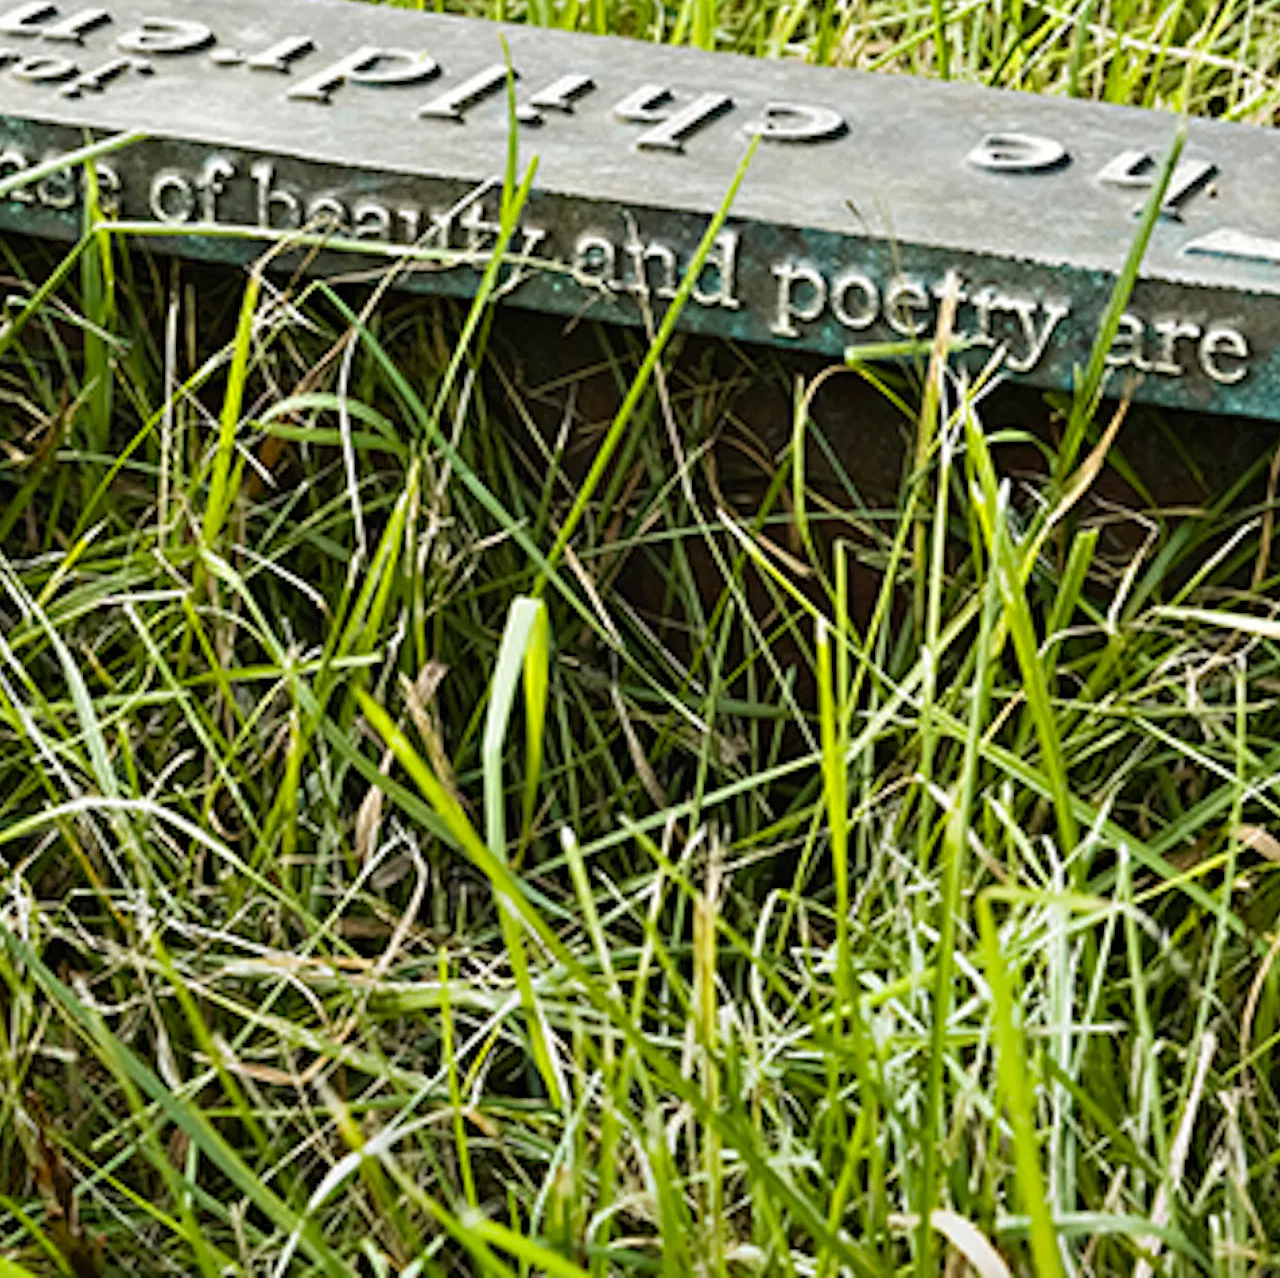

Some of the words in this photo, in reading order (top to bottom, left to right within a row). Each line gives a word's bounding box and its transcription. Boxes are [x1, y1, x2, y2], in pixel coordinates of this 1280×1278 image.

[149, 155, 235, 223] of
[572, 226, 740, 310] and
[771, 262, 1071, 372] poetry
[1104, 312, 1249, 385] are
